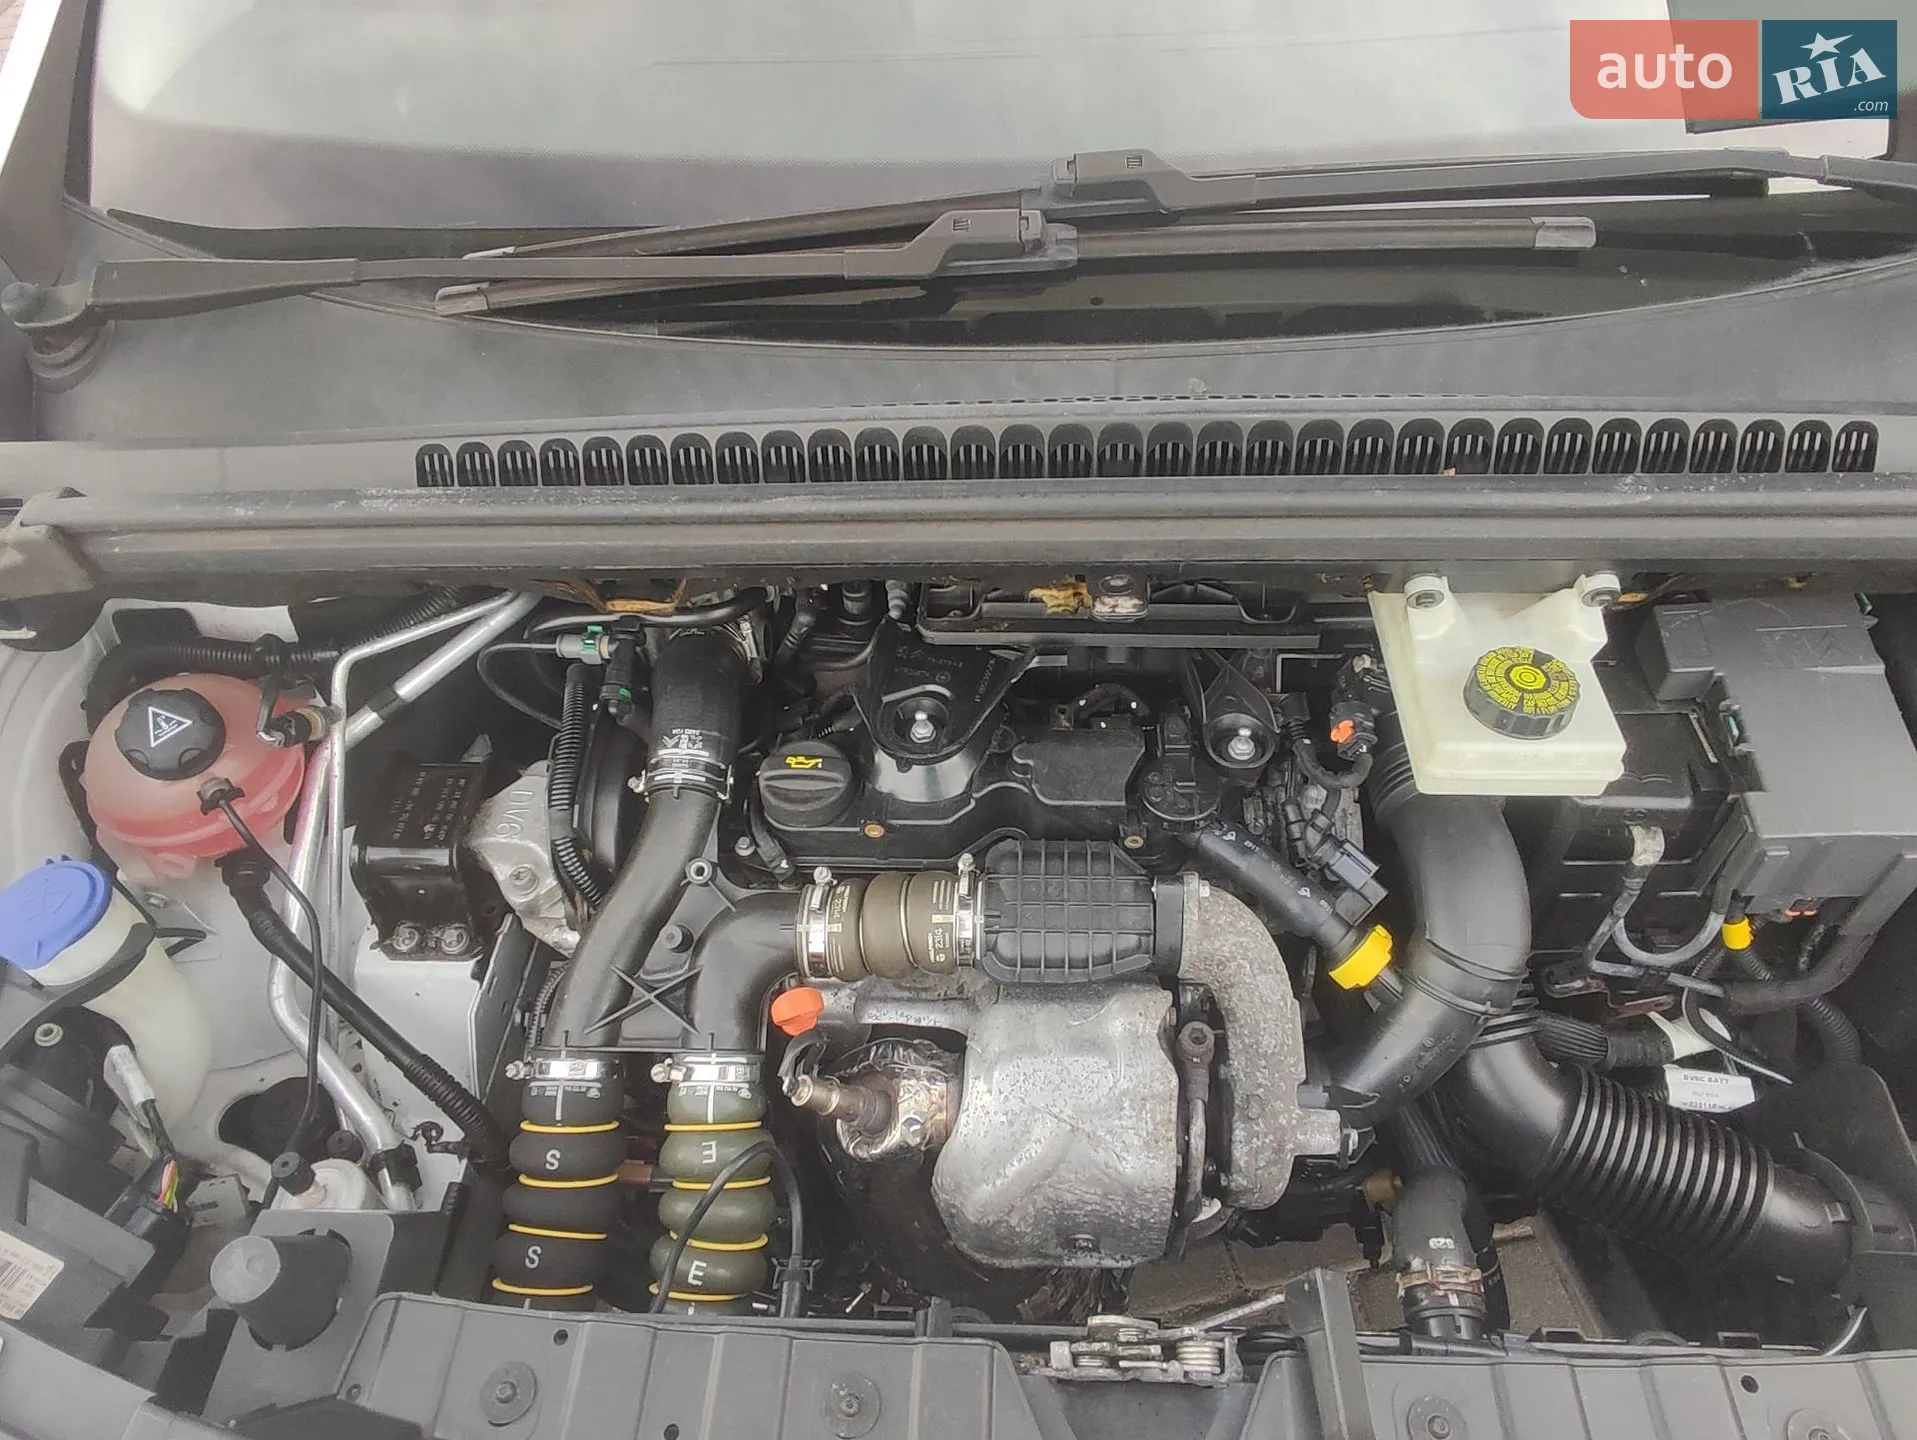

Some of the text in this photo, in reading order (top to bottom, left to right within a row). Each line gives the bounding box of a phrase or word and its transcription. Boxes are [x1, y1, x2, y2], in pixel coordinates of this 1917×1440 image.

[545, 1149, 561, 1170] S
[524, 1245, 542, 1269] S
[687, 1260, 707, 1286] E
